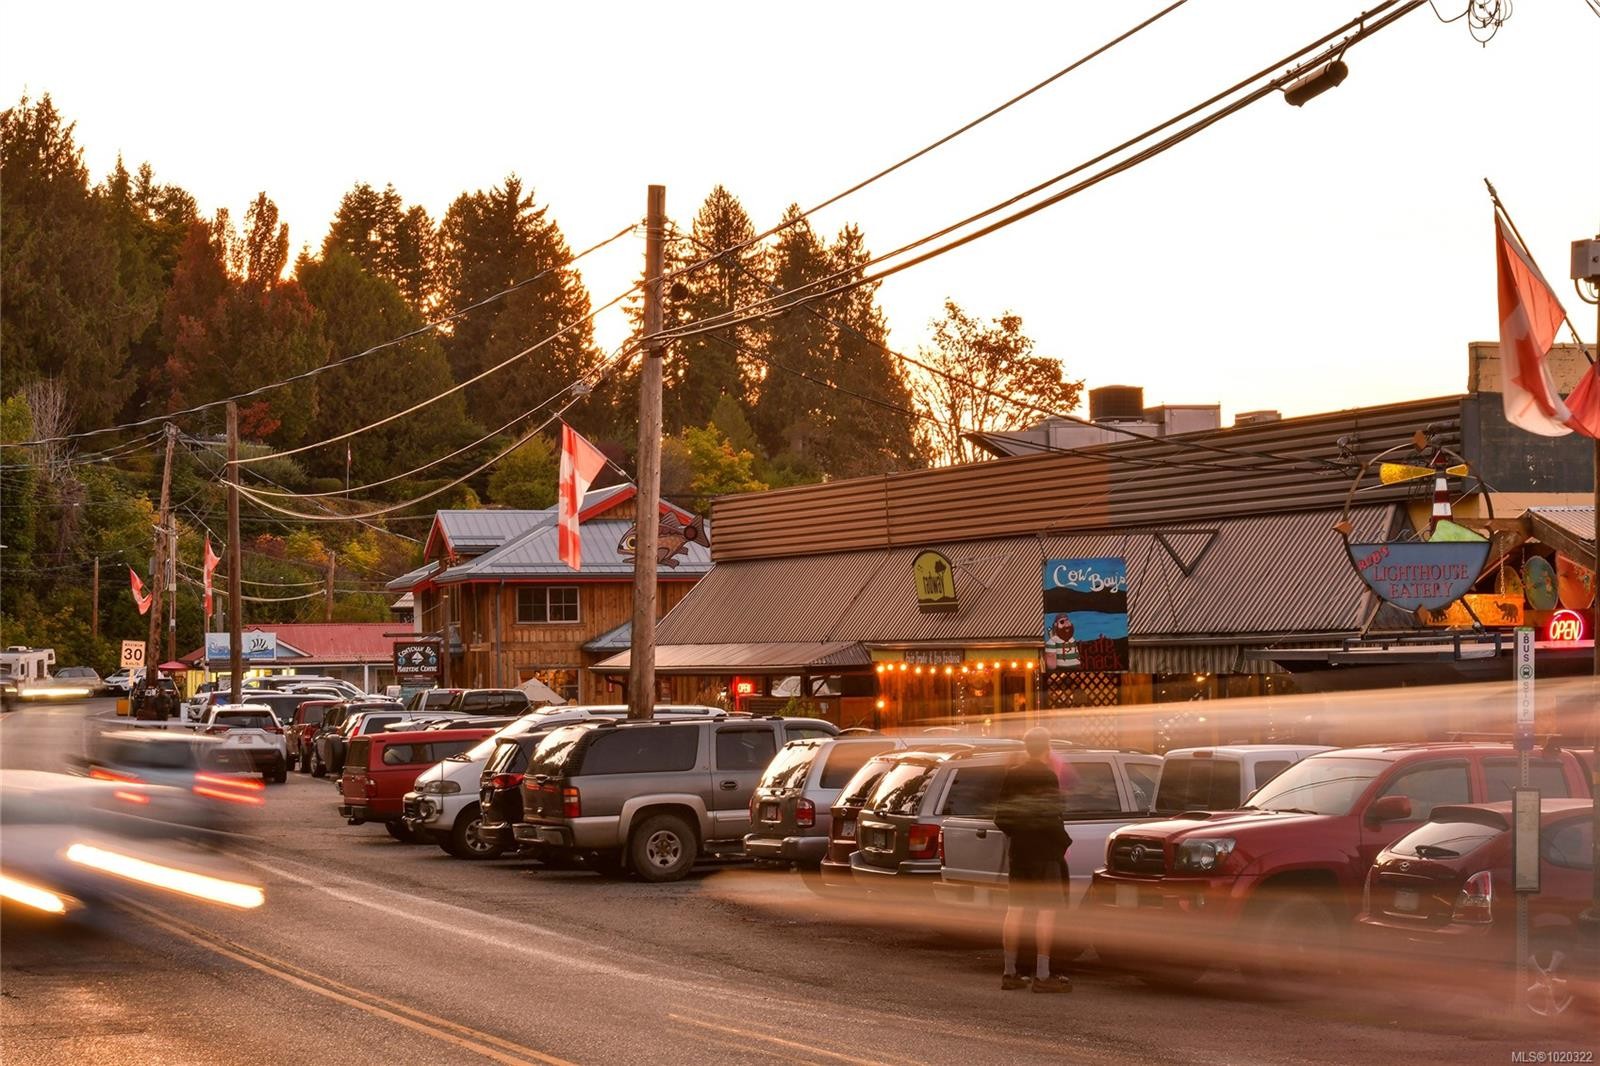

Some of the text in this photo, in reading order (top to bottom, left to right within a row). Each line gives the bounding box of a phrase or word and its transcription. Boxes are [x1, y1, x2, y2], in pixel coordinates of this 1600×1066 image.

[1053, 564, 1092, 587] Cow
[1373, 563, 1469, 581] LIGHTHOUSE
[1390, 582, 1453, 598] EATERY
[1550, 620, 1580, 640] OPEN
[124, 648, 142, 661] 30
